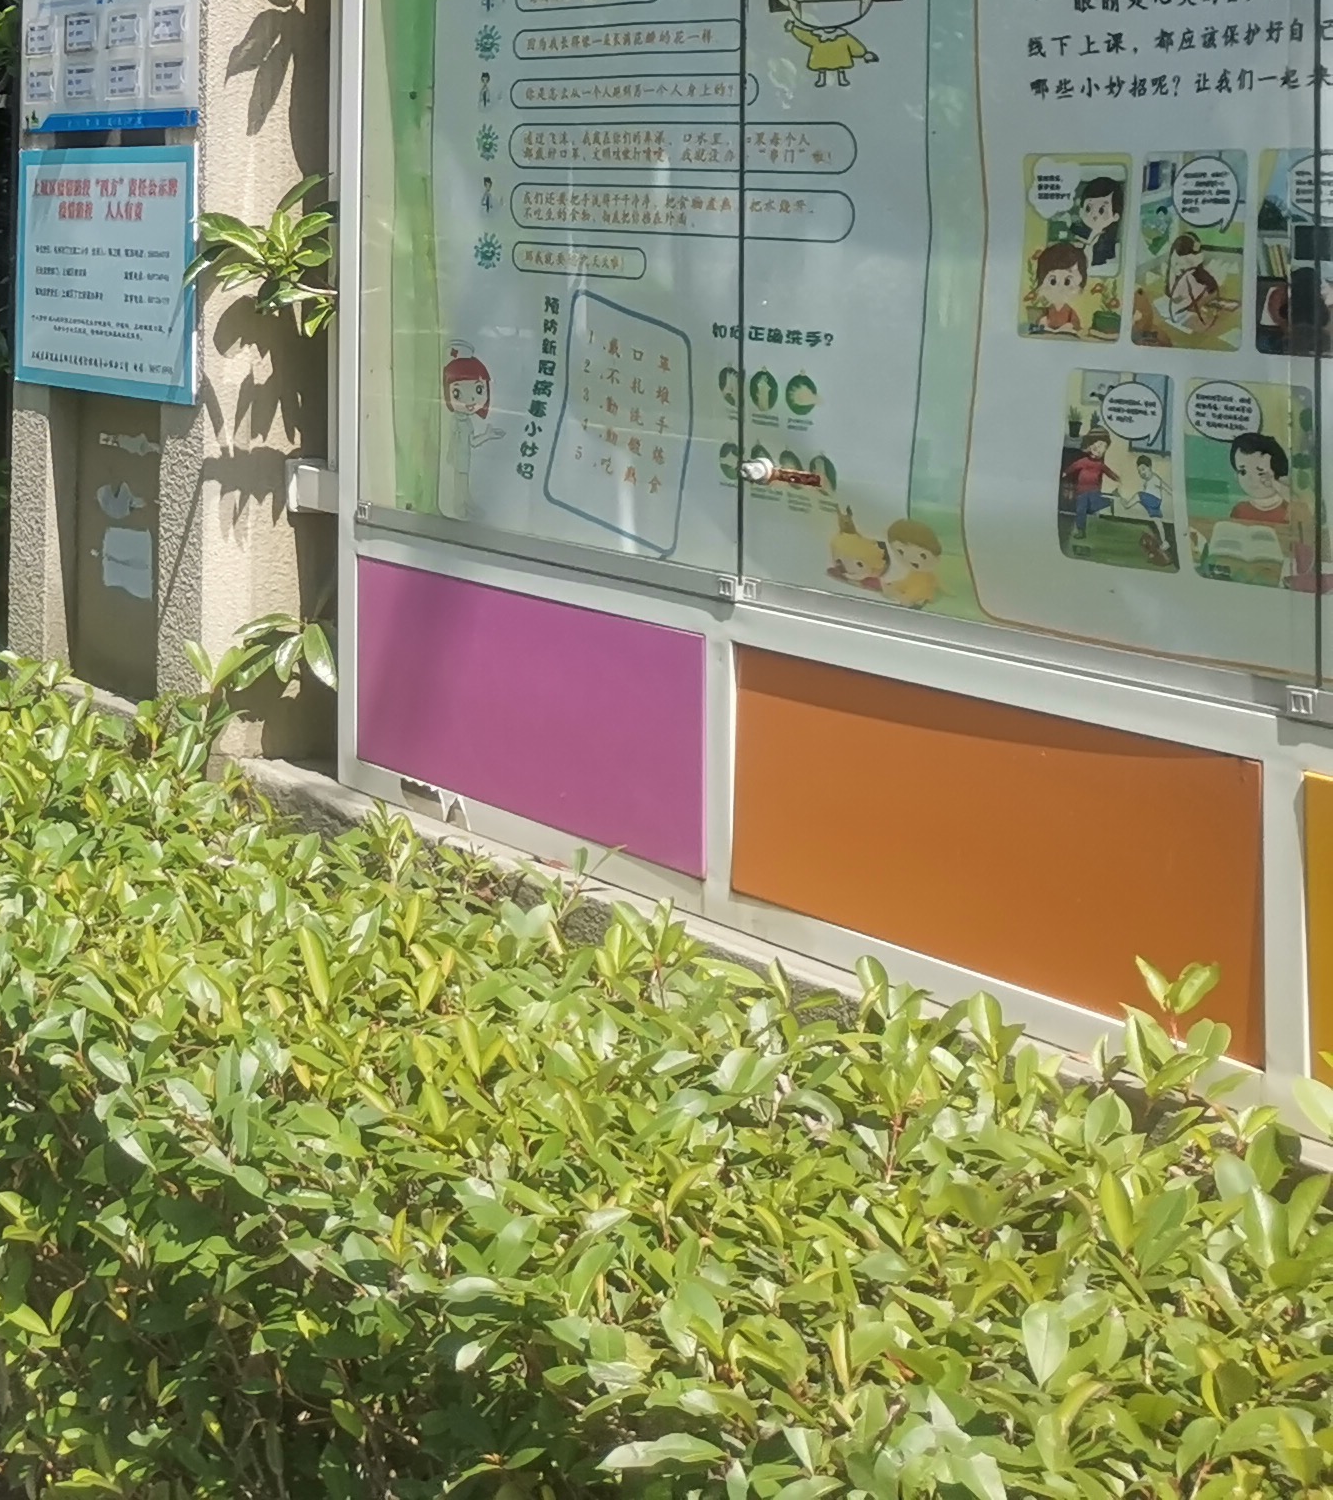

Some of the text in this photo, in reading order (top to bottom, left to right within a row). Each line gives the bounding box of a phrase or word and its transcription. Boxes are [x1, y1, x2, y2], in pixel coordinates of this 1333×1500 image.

[712, 322, 834, 347] 如何正确洗手？
[516, 296, 560, 480] 预防新冠病毒小妙招
